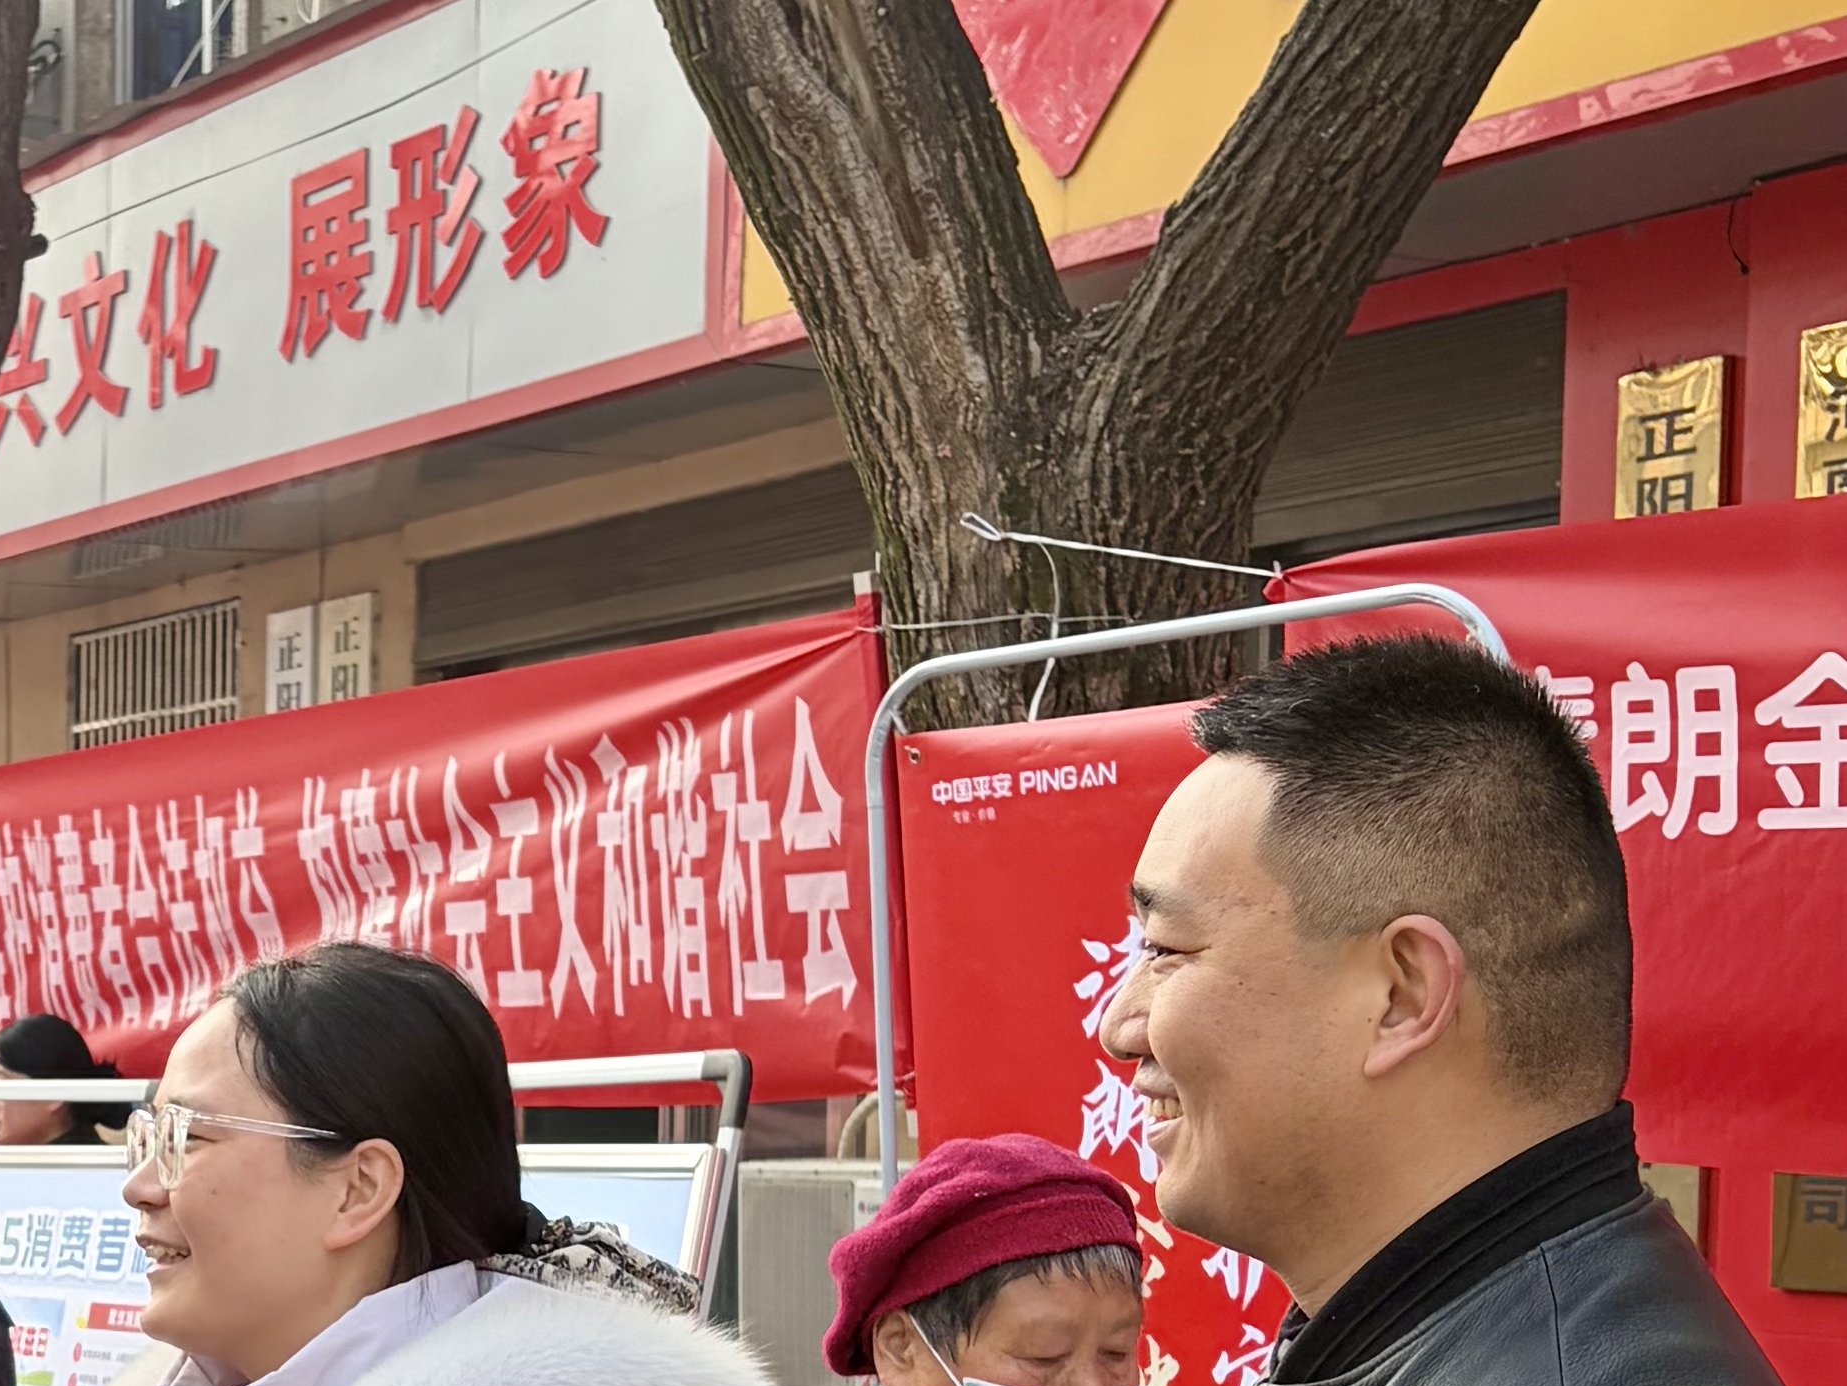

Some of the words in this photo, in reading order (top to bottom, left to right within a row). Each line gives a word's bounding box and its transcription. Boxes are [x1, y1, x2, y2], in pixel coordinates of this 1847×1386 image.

[279, 66, 610, 364] 展形象
[1635, 405, 1698, 516] 正阳
[297, 696, 858, 1020] 构建社会主义和谐社会
[931, 778, 1013, 806] 中国平安
